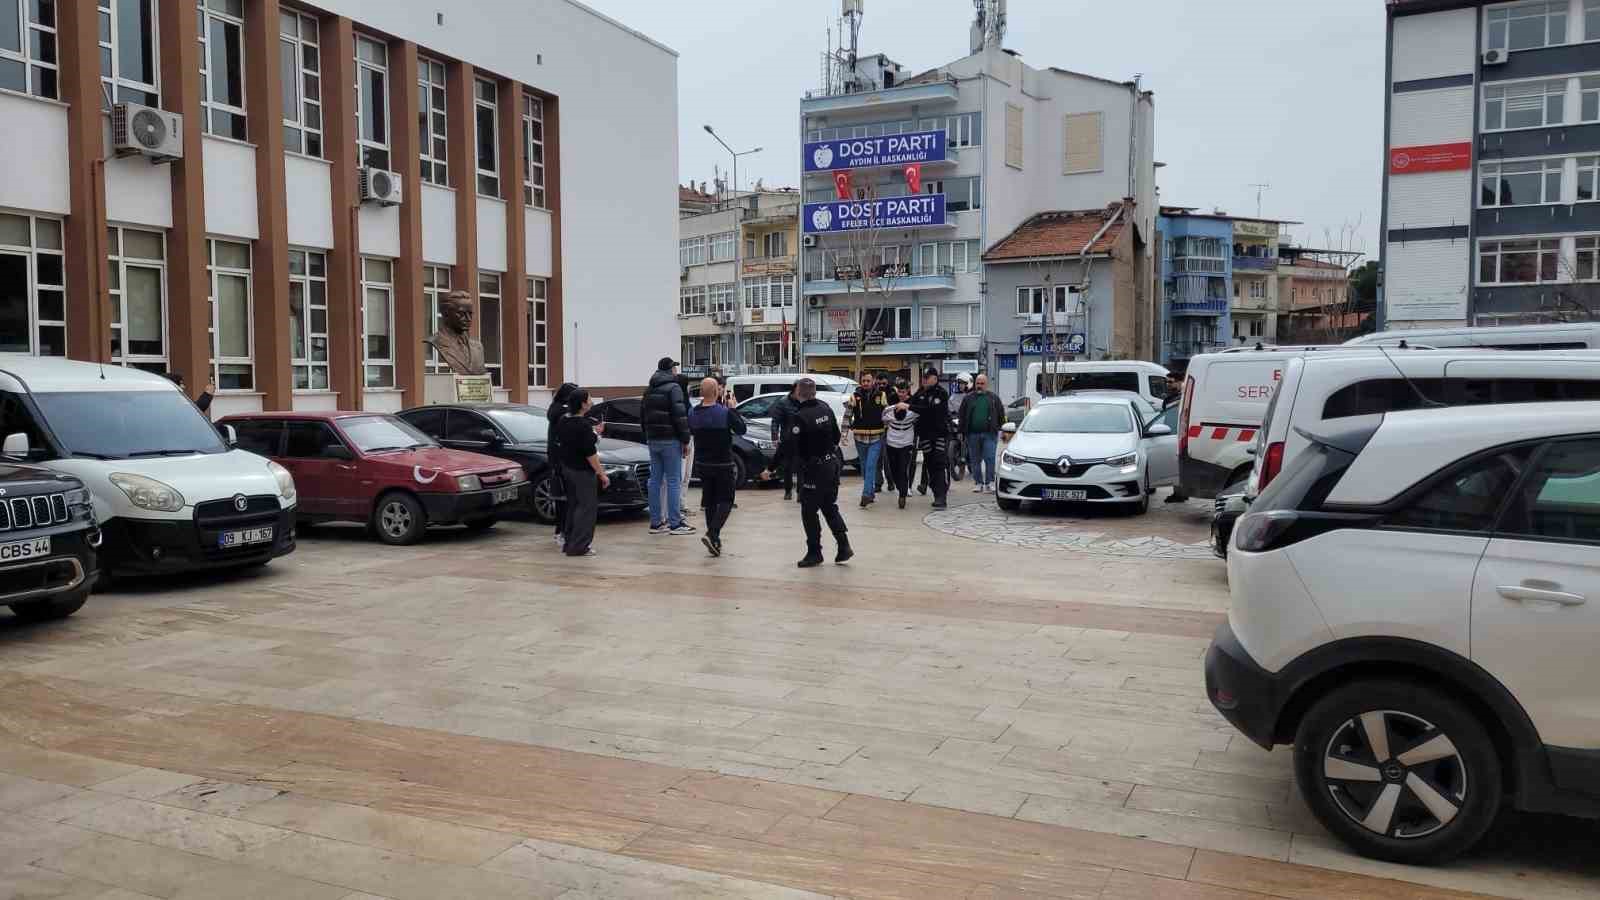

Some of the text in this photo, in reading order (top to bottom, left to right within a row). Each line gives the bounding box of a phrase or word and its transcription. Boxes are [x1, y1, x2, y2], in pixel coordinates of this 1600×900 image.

[840, 135, 936, 157] DOST PARTİ
[849, 157, 872, 167] AYDIN
[838, 198, 935, 218] DOST PARTİ
[225, 533, 235, 544] 09
[0, 540, 49, 560] CBS 44
